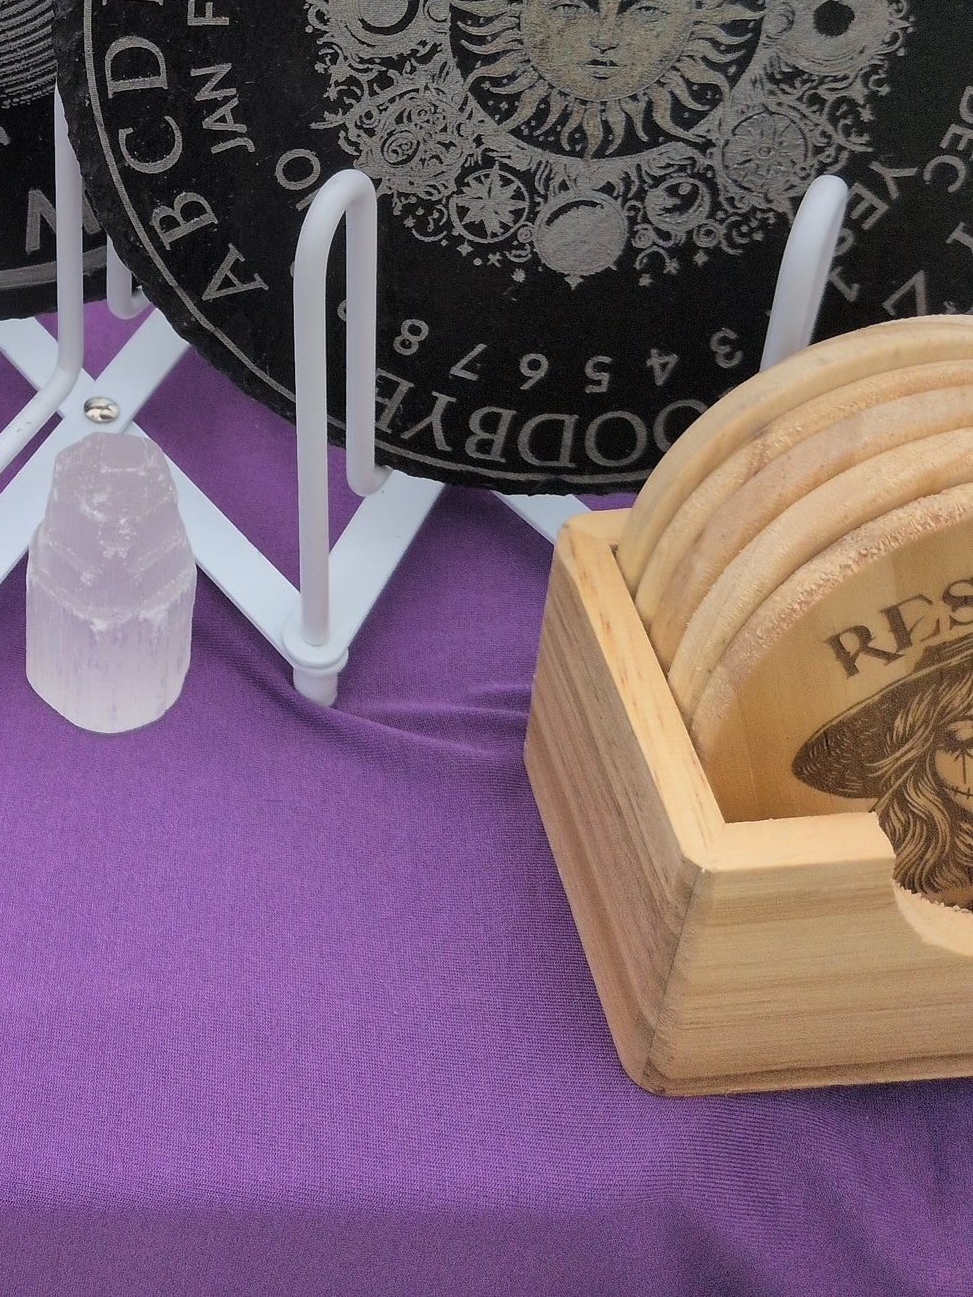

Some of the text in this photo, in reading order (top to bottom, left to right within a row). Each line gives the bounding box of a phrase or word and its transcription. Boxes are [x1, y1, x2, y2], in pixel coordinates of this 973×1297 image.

[191, 62, 256, 155] JAN
[275, 148, 326, 211] O
[393, 318, 429, 355] 8
[710, 328, 742, 368] 3
[448, 343, 488, 381] 7
[584, 355, 613, 394] 5
[645, 348, 678, 386] 4
[375, 367, 710, 468] OODBYE
